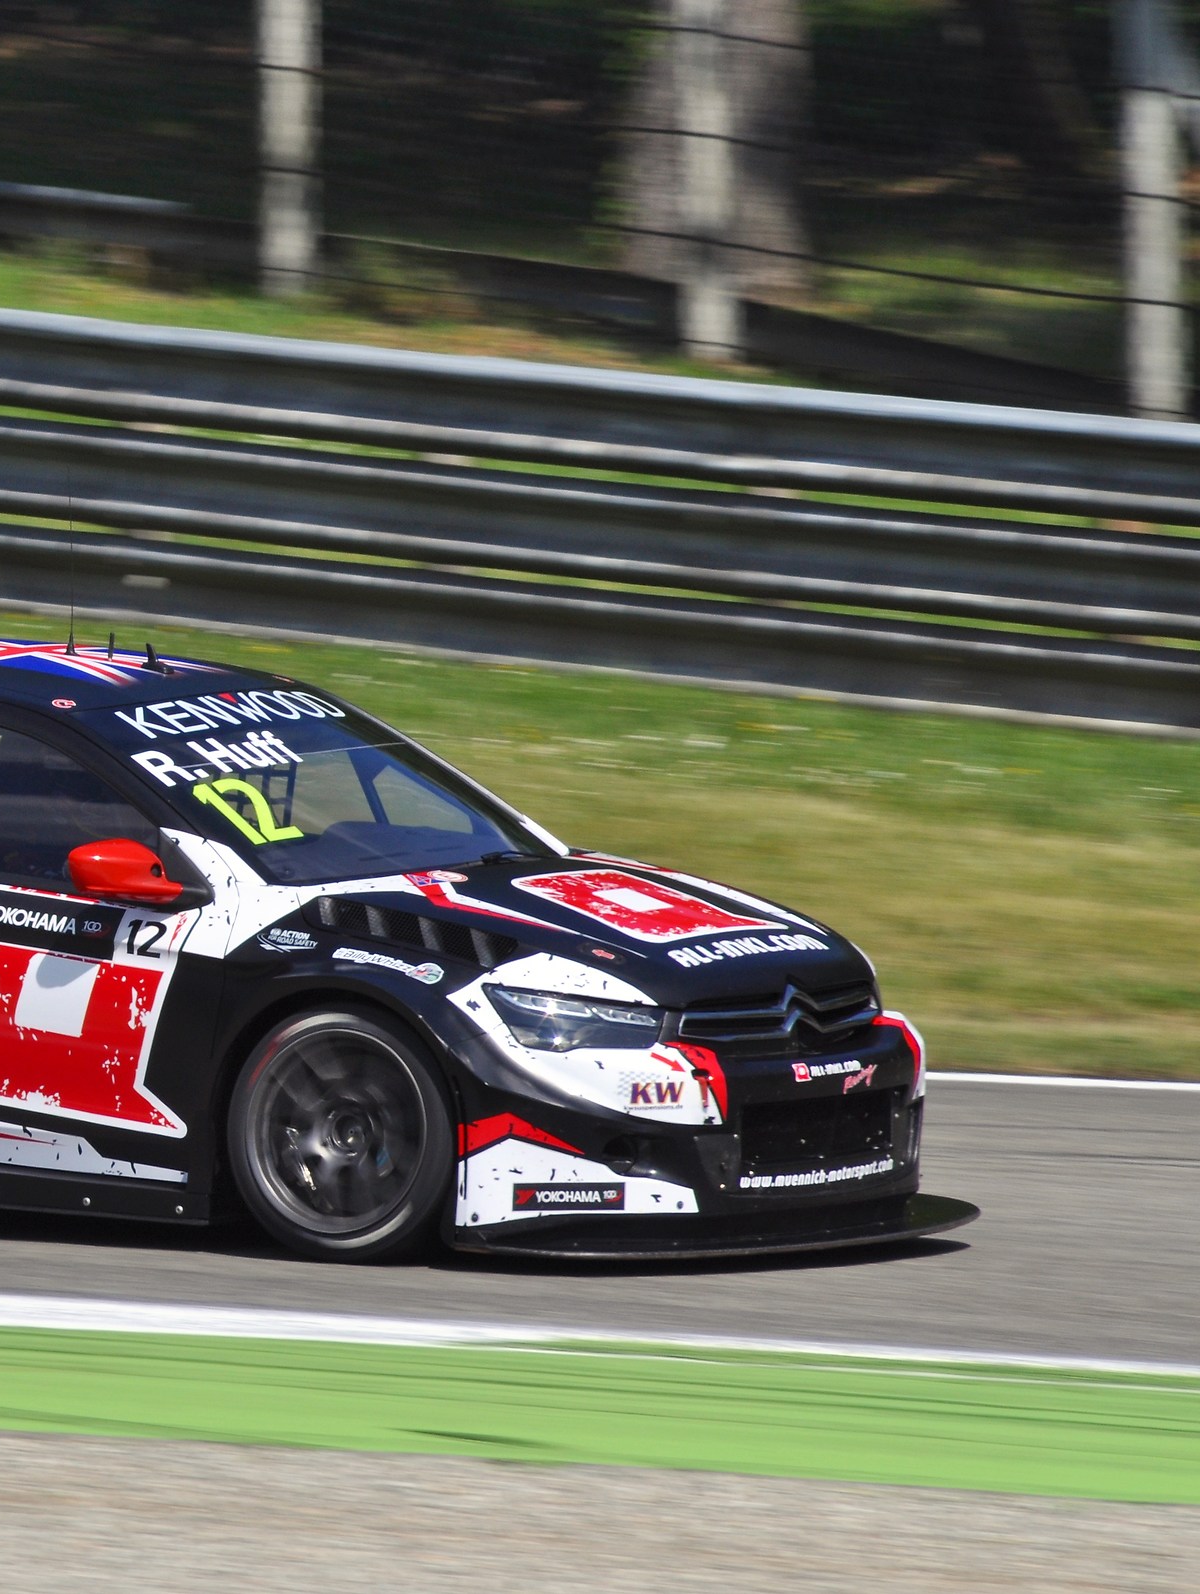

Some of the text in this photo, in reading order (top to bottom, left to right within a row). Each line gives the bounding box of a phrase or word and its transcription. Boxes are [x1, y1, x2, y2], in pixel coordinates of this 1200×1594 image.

[114, 690, 346, 739] KENWOOD
[192, 778, 304, 845] 12
[126, 918, 168, 959] 12
[276, 936, 294, 944] ROAD
[293, 939, 318, 948] SAFETY
[280, 930, 311, 940] ACTION
[630, 1081, 684, 1104] KW
[739, 1158, 894, 1189] www.muennich-motorsport.com
[535, 1190, 602, 1203] YOKOHAMA
